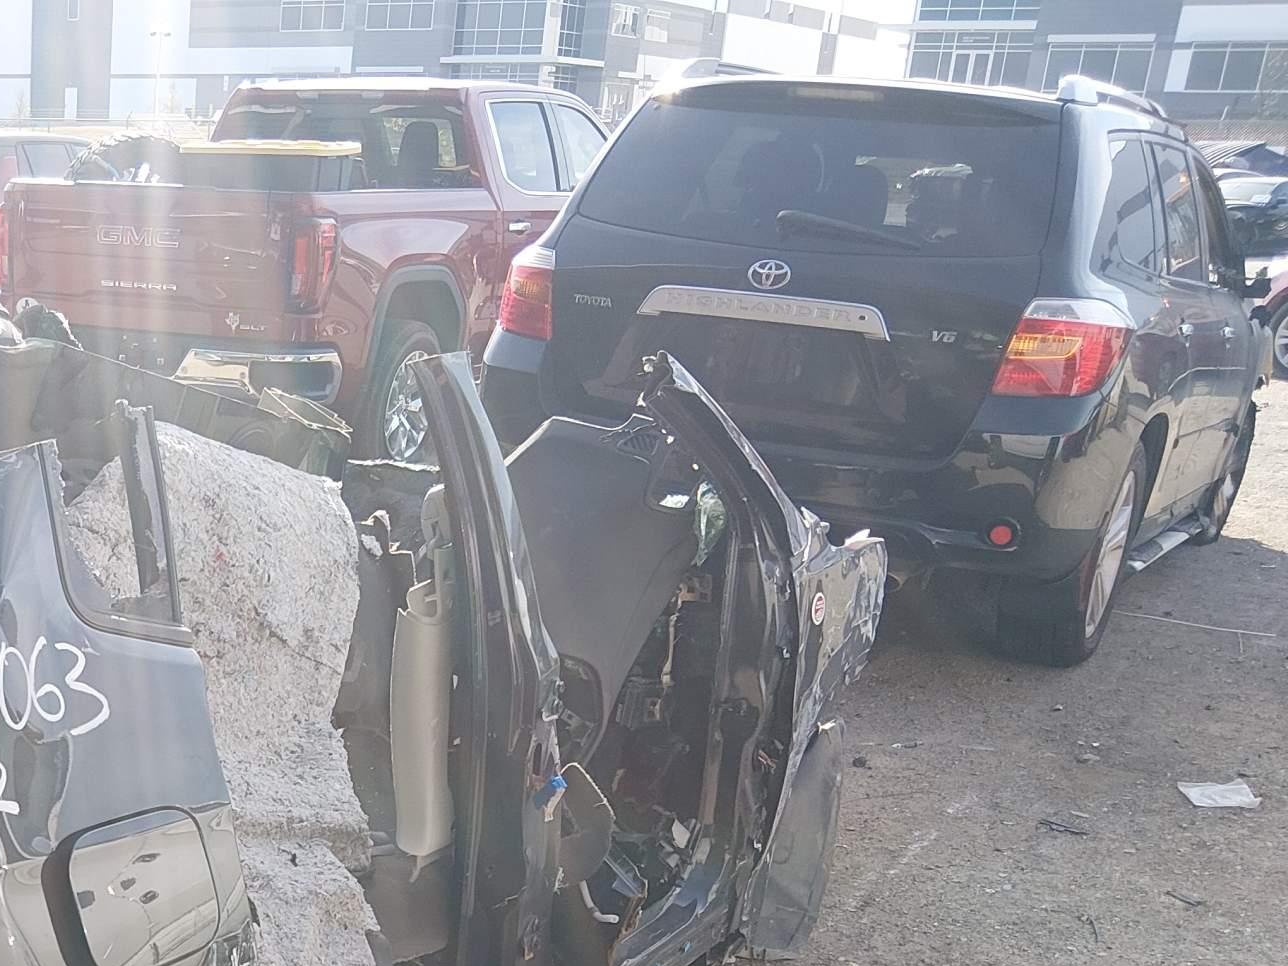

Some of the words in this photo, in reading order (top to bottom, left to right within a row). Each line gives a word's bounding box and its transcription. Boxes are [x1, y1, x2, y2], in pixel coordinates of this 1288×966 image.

[97, 224, 181, 248] GMC
[100, 279, 177, 291] SIERRA
[573, 293, 612, 308] TOYOTA
[665, 291, 853, 323] HIGHLANDER
[932, 330, 958, 342] V6
